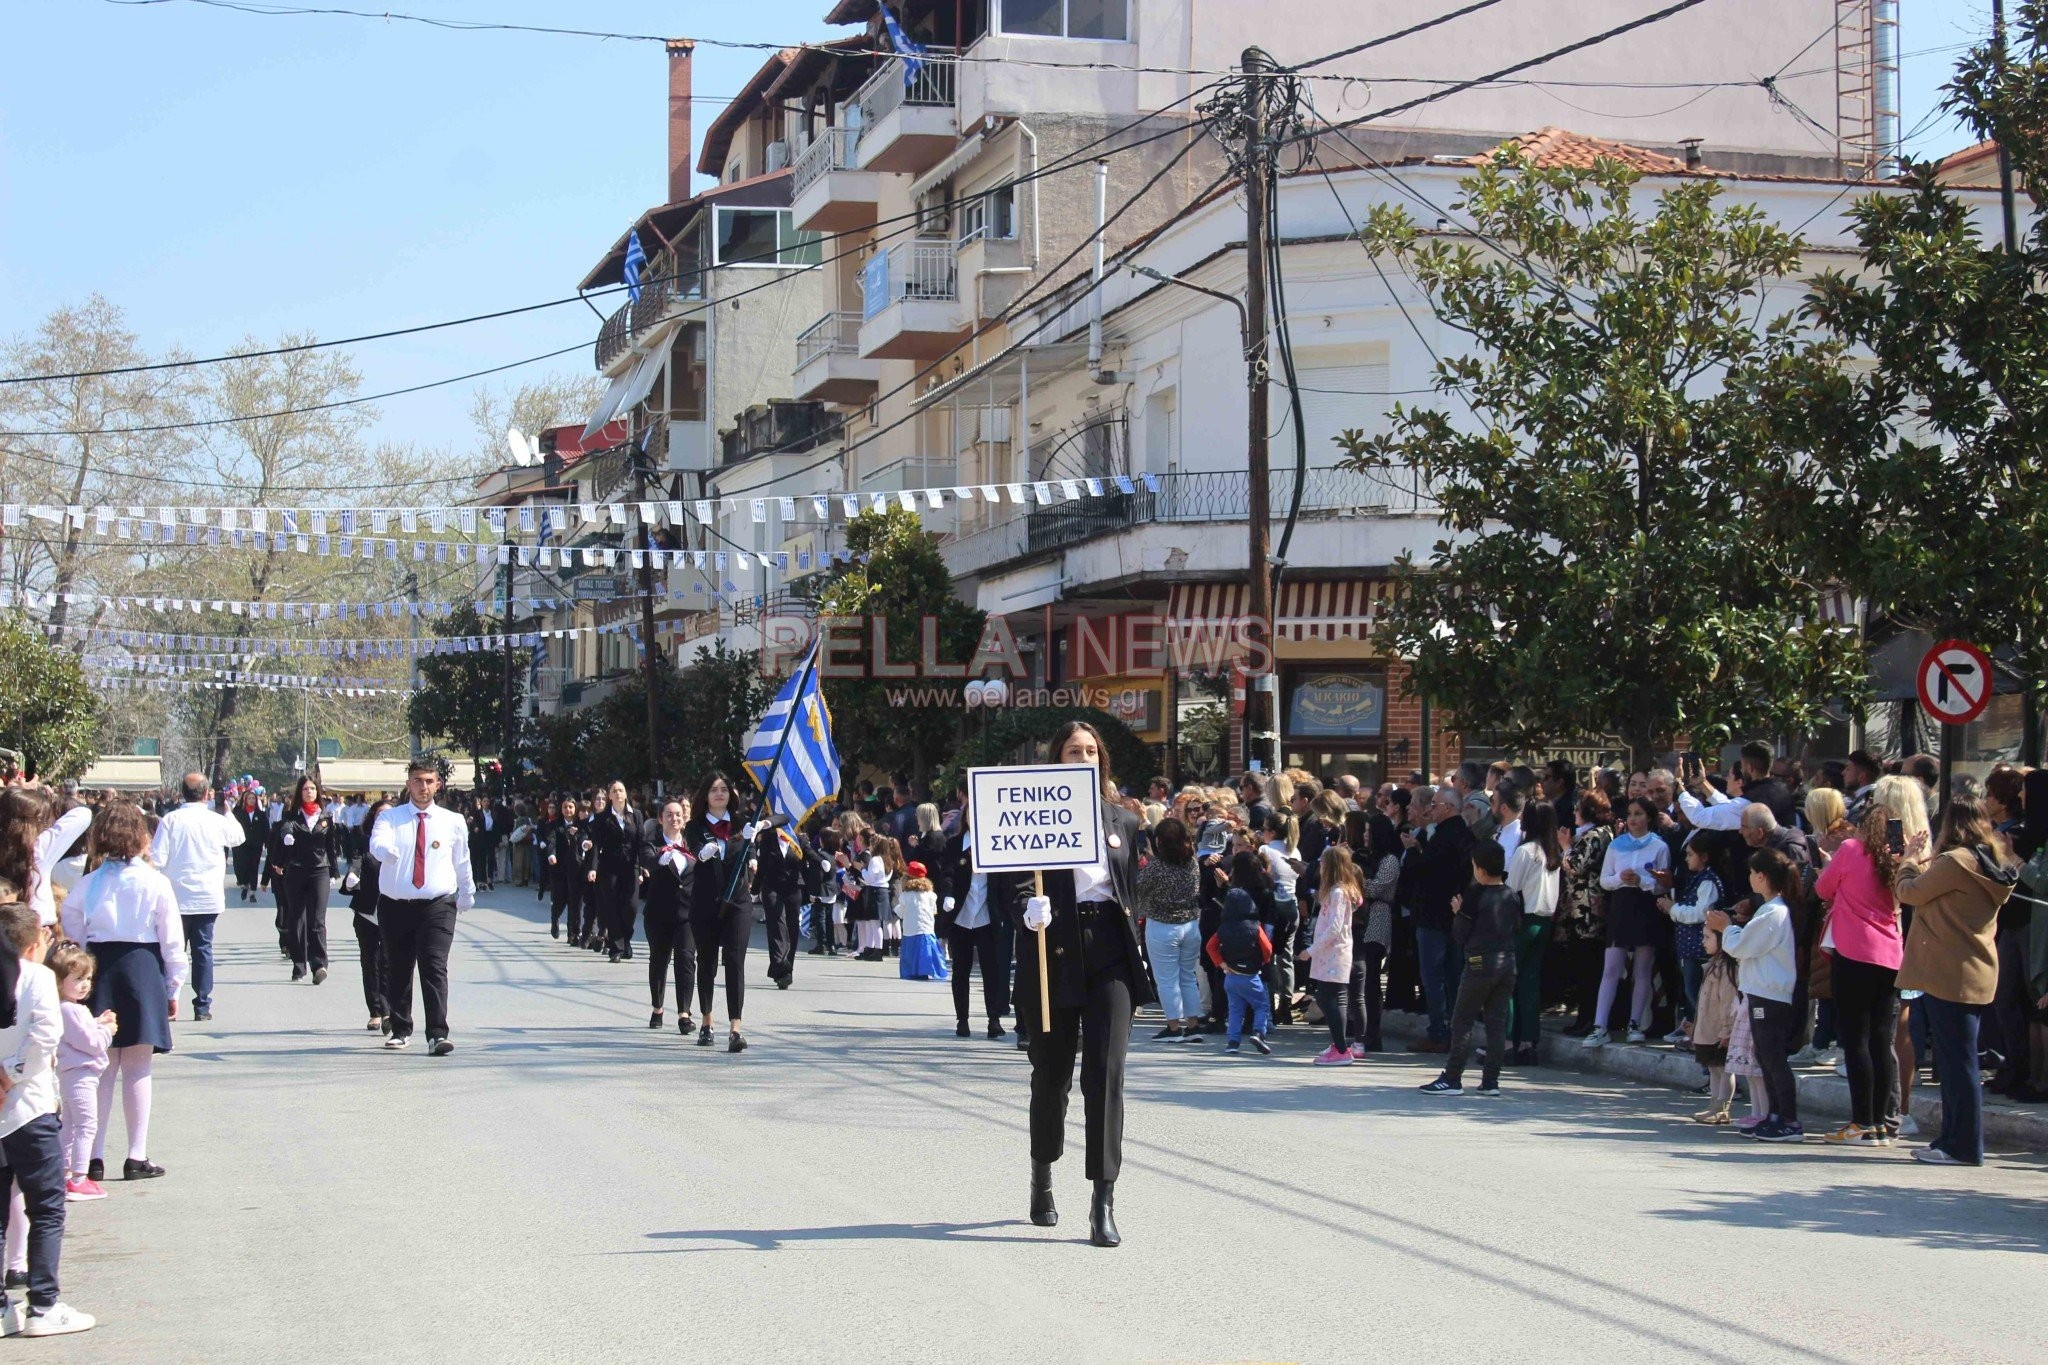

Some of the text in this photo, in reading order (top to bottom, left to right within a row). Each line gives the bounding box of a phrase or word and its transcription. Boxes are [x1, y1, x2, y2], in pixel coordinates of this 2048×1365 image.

[997, 785, 1072, 803] ΓΕΝΙΚΟ
[998, 808, 1073, 827] ΛΥΚΕΙΟ
[991, 832, 1082, 851] ΣΚΥΔΡΑΣ
